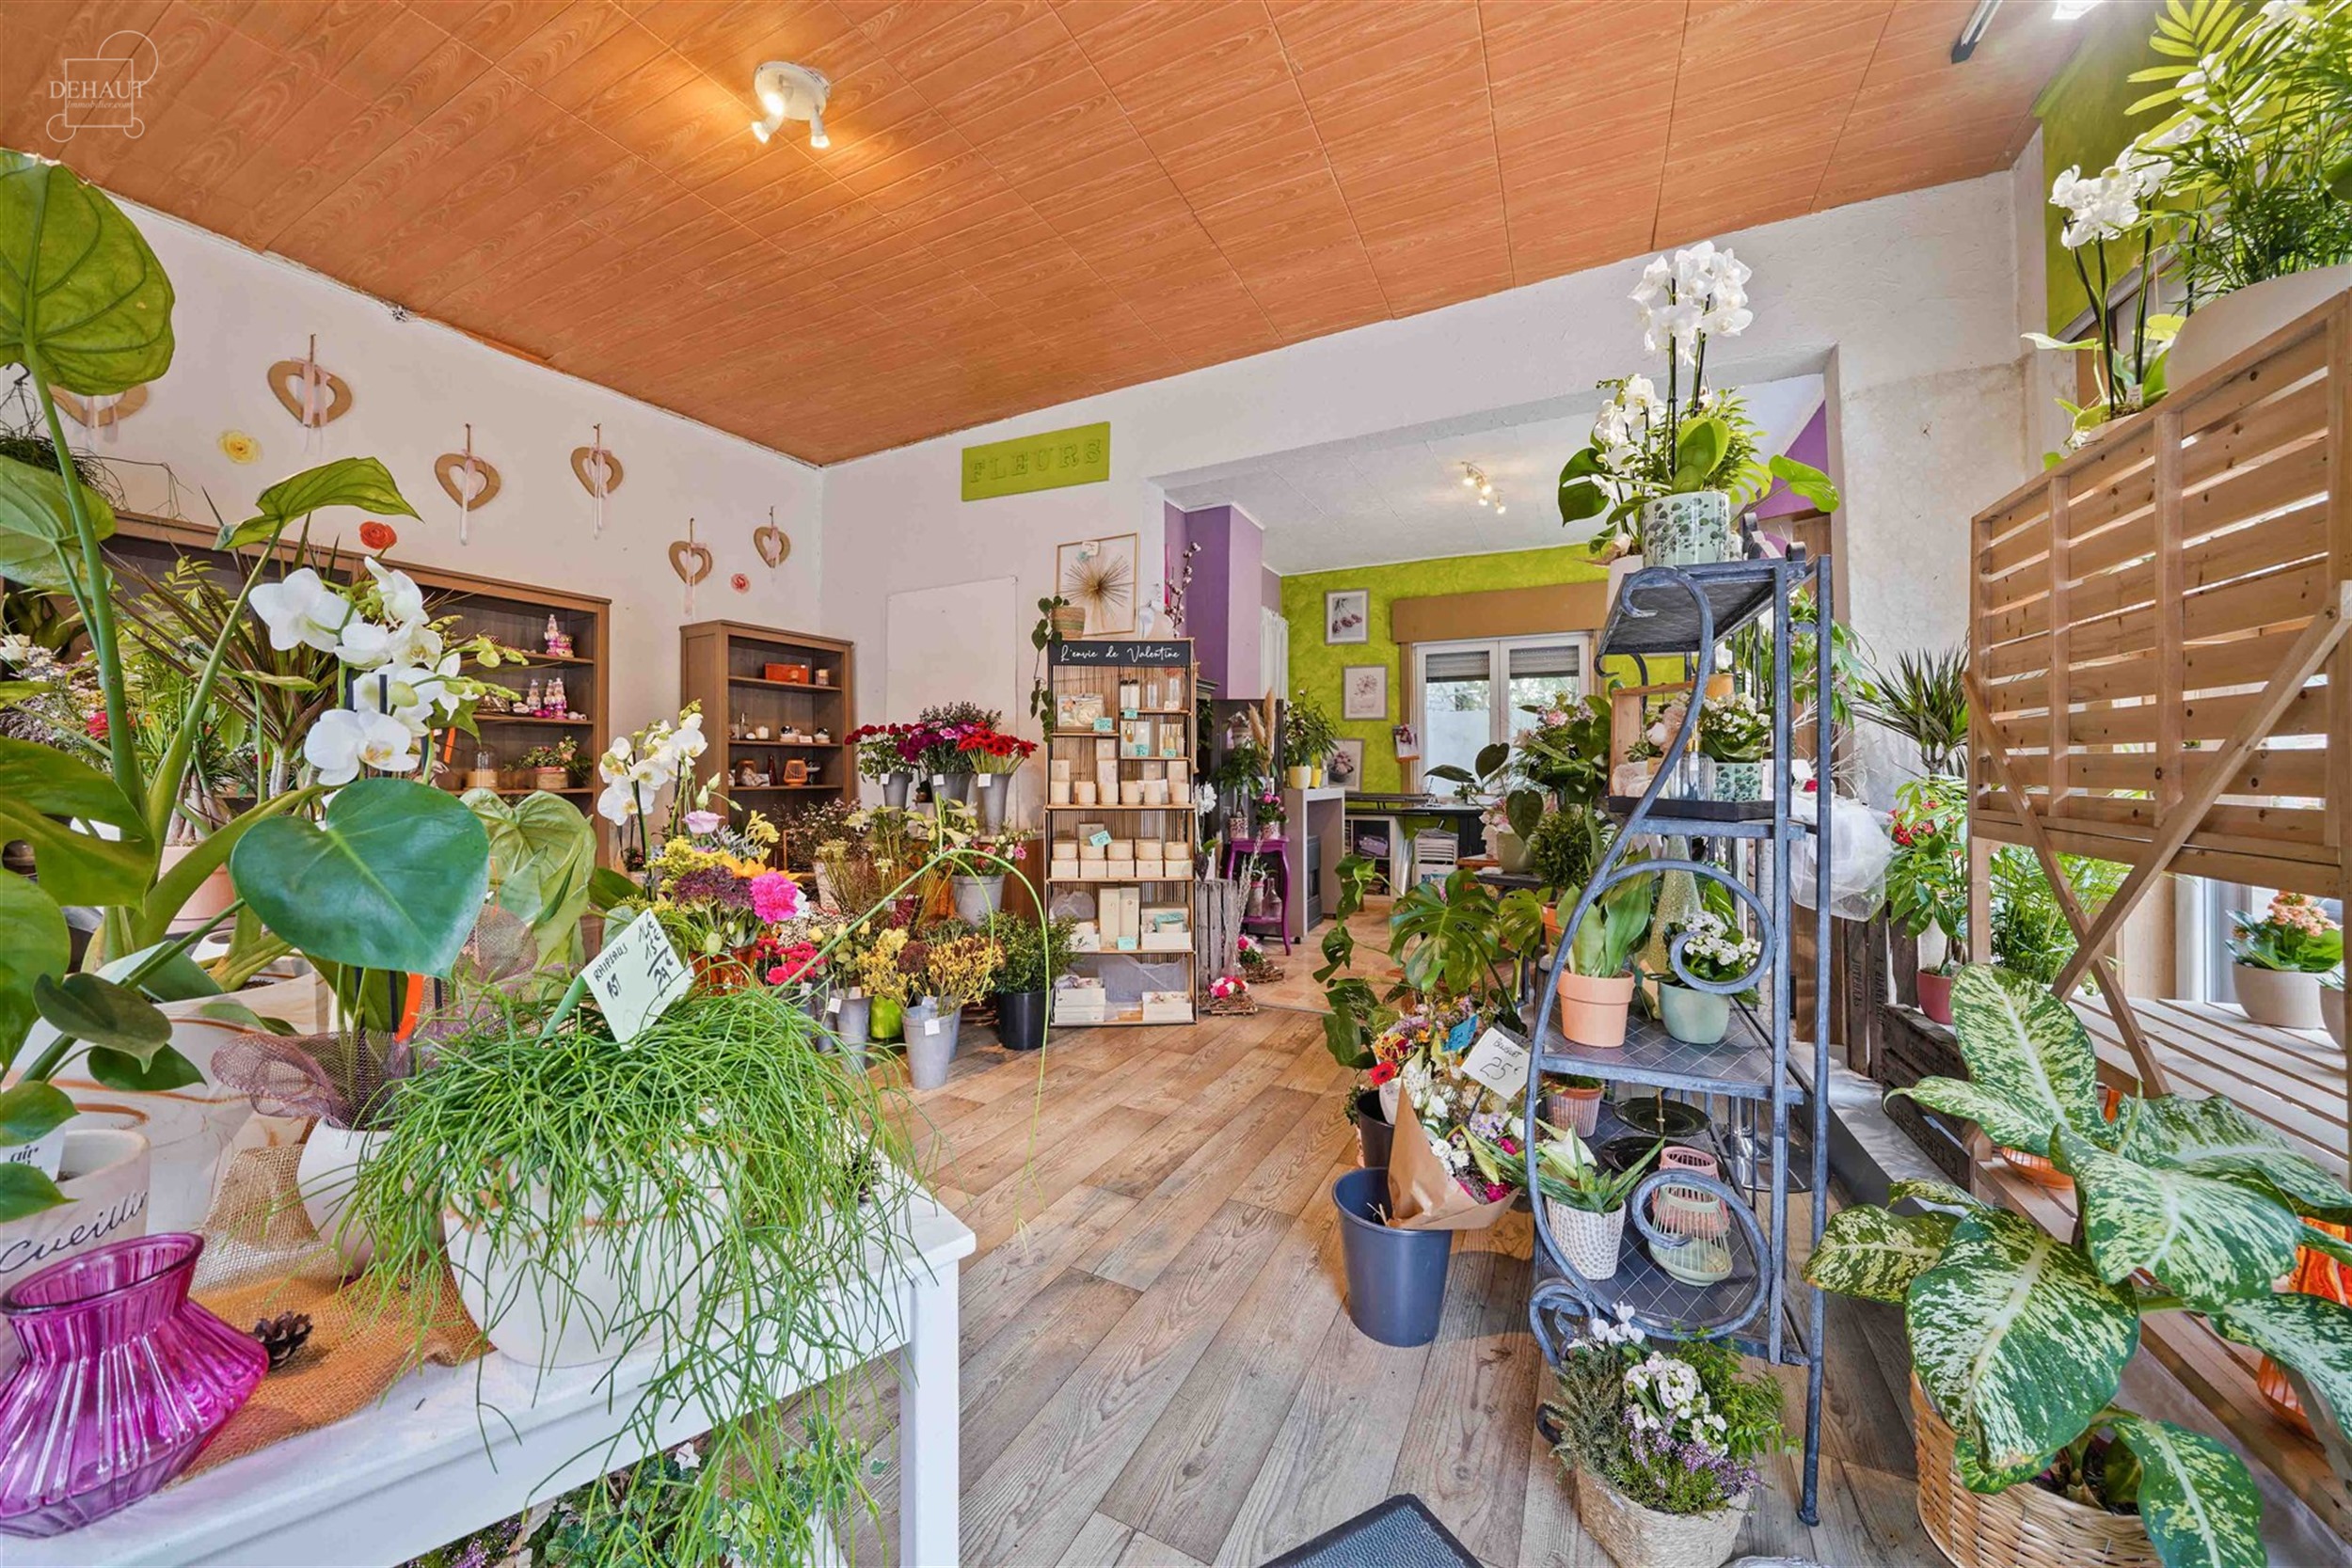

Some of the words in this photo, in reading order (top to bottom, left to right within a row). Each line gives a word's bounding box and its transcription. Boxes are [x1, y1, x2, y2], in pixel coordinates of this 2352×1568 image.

[970, 438, 1102, 483] FLEURS
[1060, 644, 1099, 662] L'envie
[1105, 645, 1120, 658] de
[1126, 645, 1181, 662] Valentine
